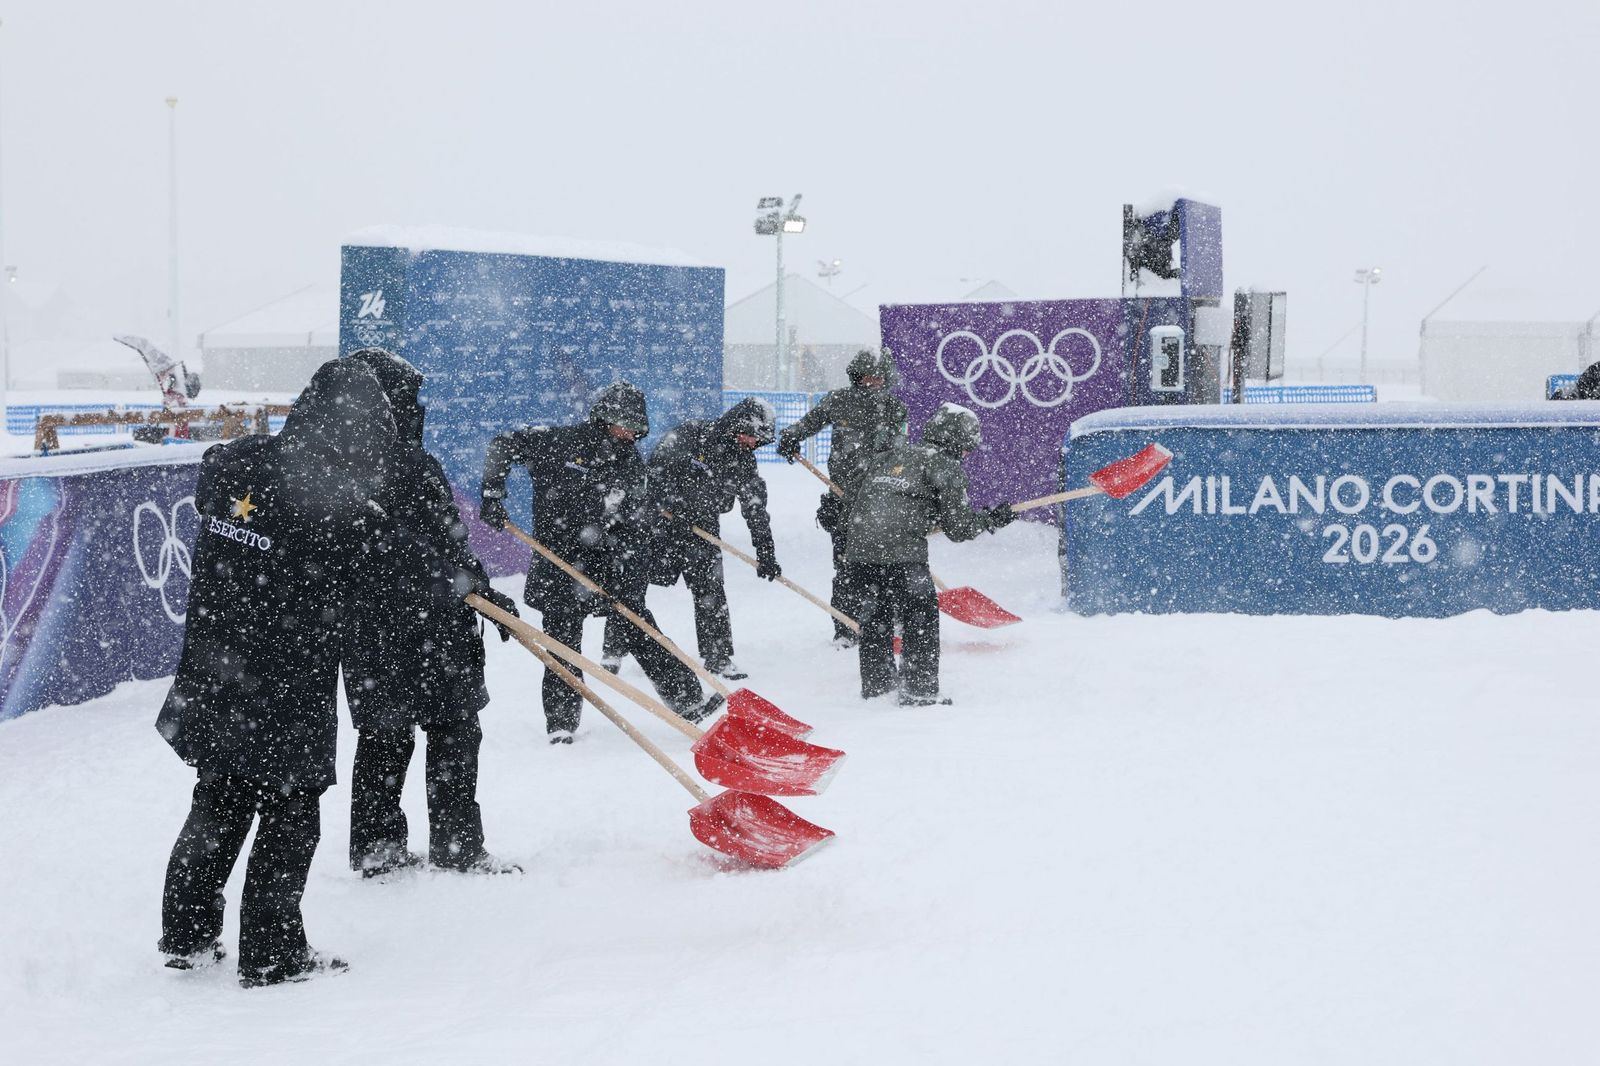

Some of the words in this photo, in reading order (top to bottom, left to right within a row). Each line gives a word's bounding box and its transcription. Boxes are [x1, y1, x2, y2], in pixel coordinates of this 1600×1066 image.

[1128, 474, 1370, 515] MILANO
[209, 515, 271, 551] ESERCITO
[1322, 523, 1438, 564] 2026
